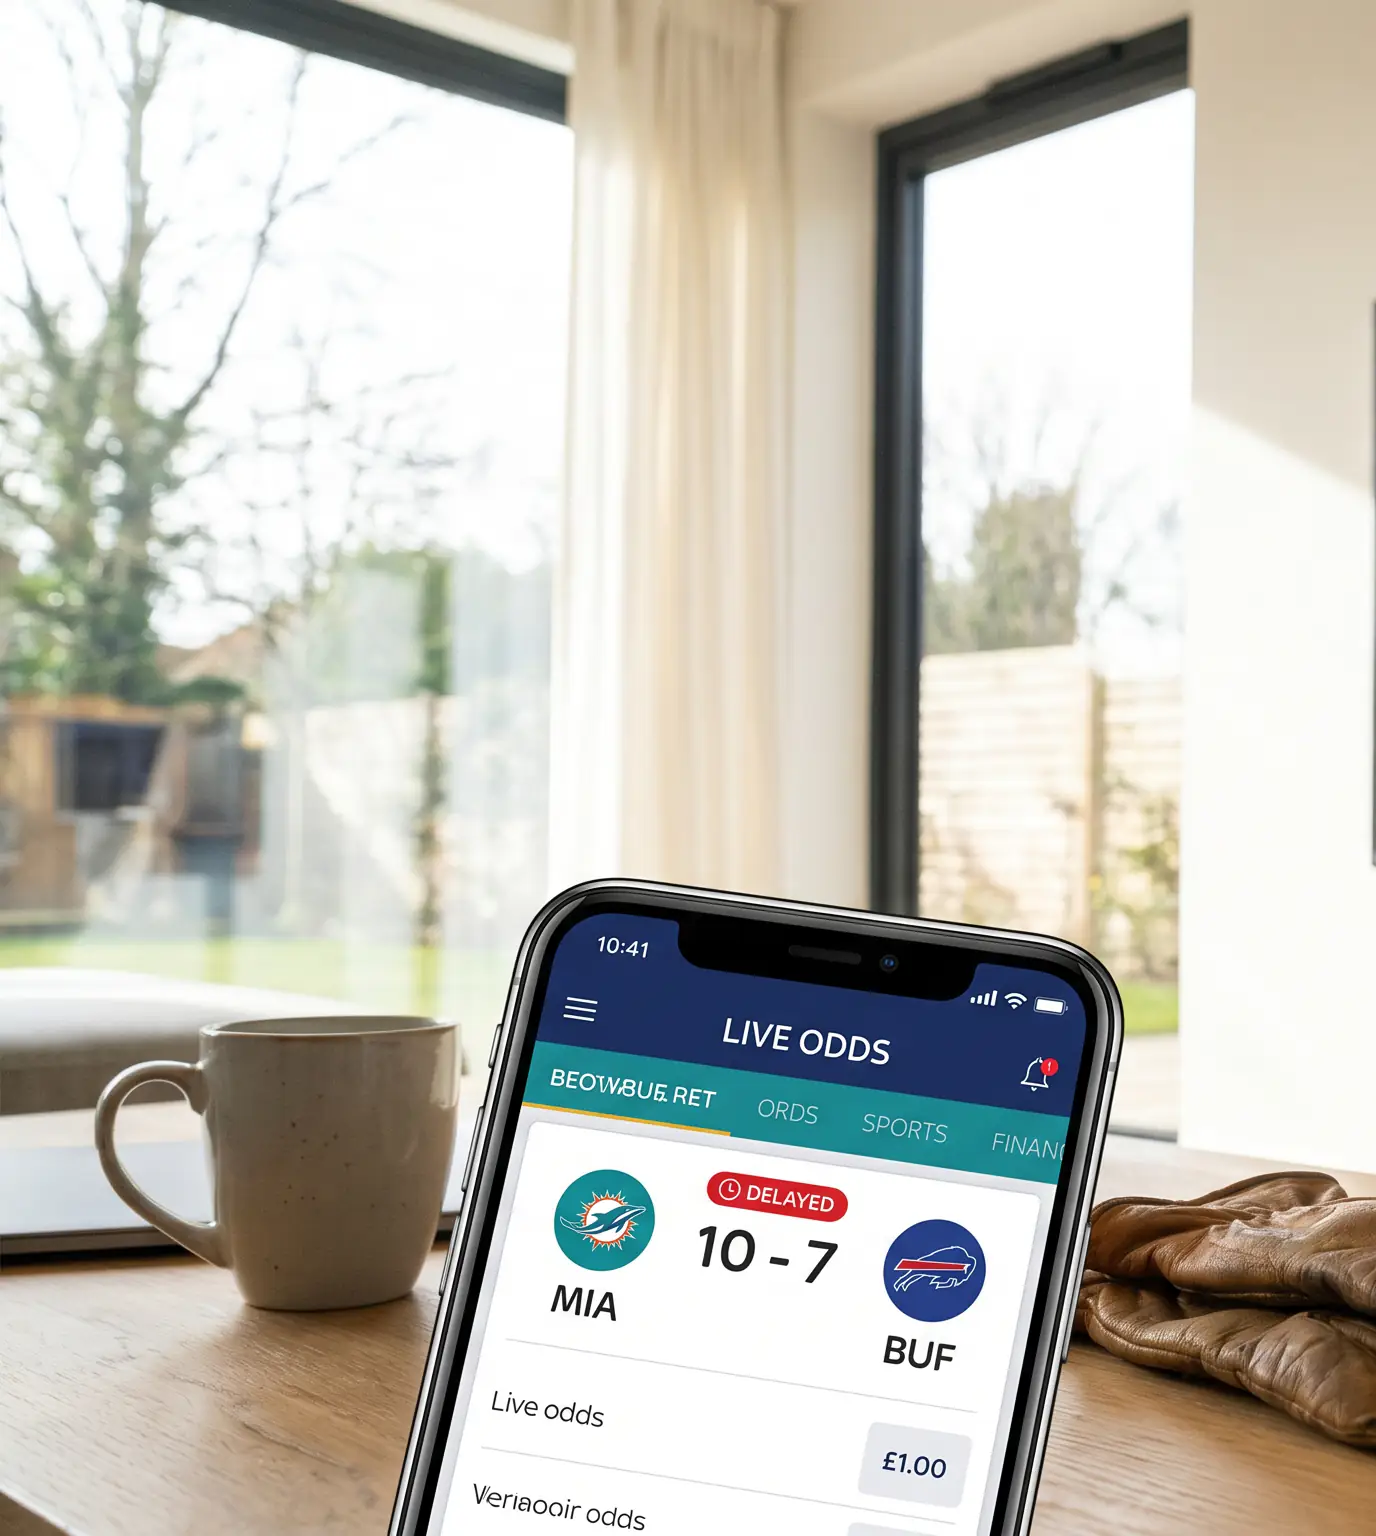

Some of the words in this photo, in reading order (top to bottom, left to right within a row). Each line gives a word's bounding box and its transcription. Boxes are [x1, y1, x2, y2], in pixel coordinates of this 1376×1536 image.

[597, 935, 650, 959] 10:41
[722, 1017, 791, 1051] LIVE
[799, 1028, 891, 1066] ODDS
[673, 1086, 717, 1109] RET
[757, 1098, 819, 1126] ORDS
[862, 1113, 949, 1144] SPORTS
[746, 1184, 835, 1214] DELAYED
[699, 1225, 755, 1273] 10
[804, 1239, 839, 1285] 7
[550, 1284, 618, 1322] MIA
[882, 1334, 957, 1372] BUF
[491, 1390, 539, 1418] Live
[543, 1398, 605, 1429] odds
[882, 1450, 947, 1480] £1.00
[586, 1507, 646, 1531] odds
